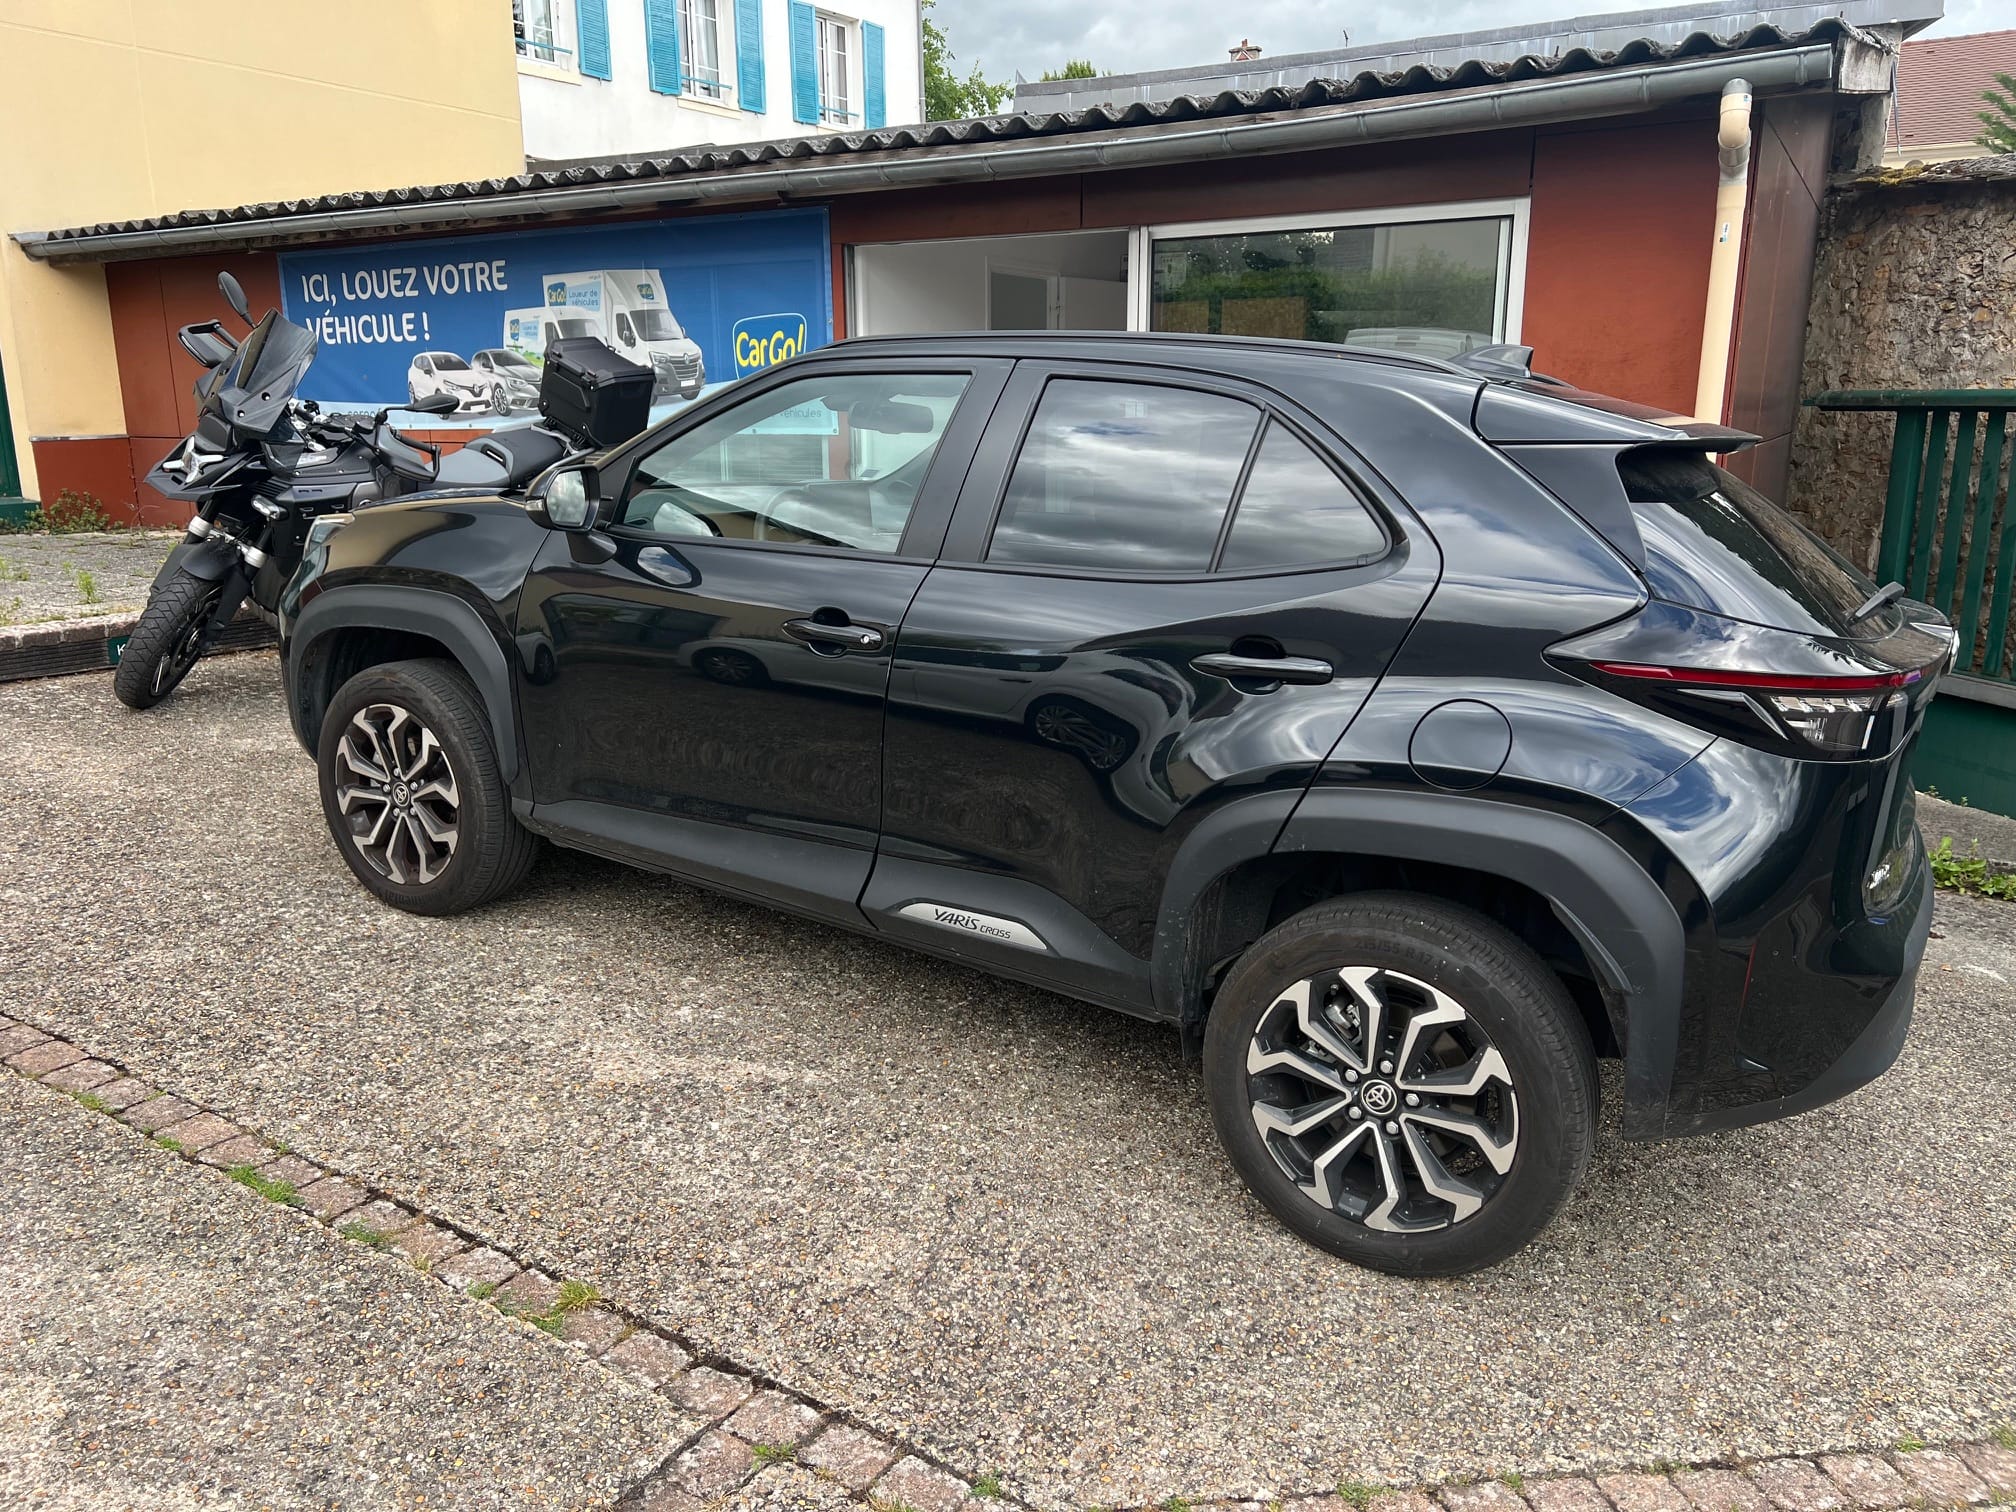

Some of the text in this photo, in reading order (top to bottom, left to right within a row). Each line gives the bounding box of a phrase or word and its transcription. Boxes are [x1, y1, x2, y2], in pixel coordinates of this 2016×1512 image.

[301, 259, 508, 307] ICI, LOUEZ VOTRE
[589, 289, 598, 297] de
[305, 309, 431, 345] VÉHICULE !
[980, 925, 1011, 939] CROSS
